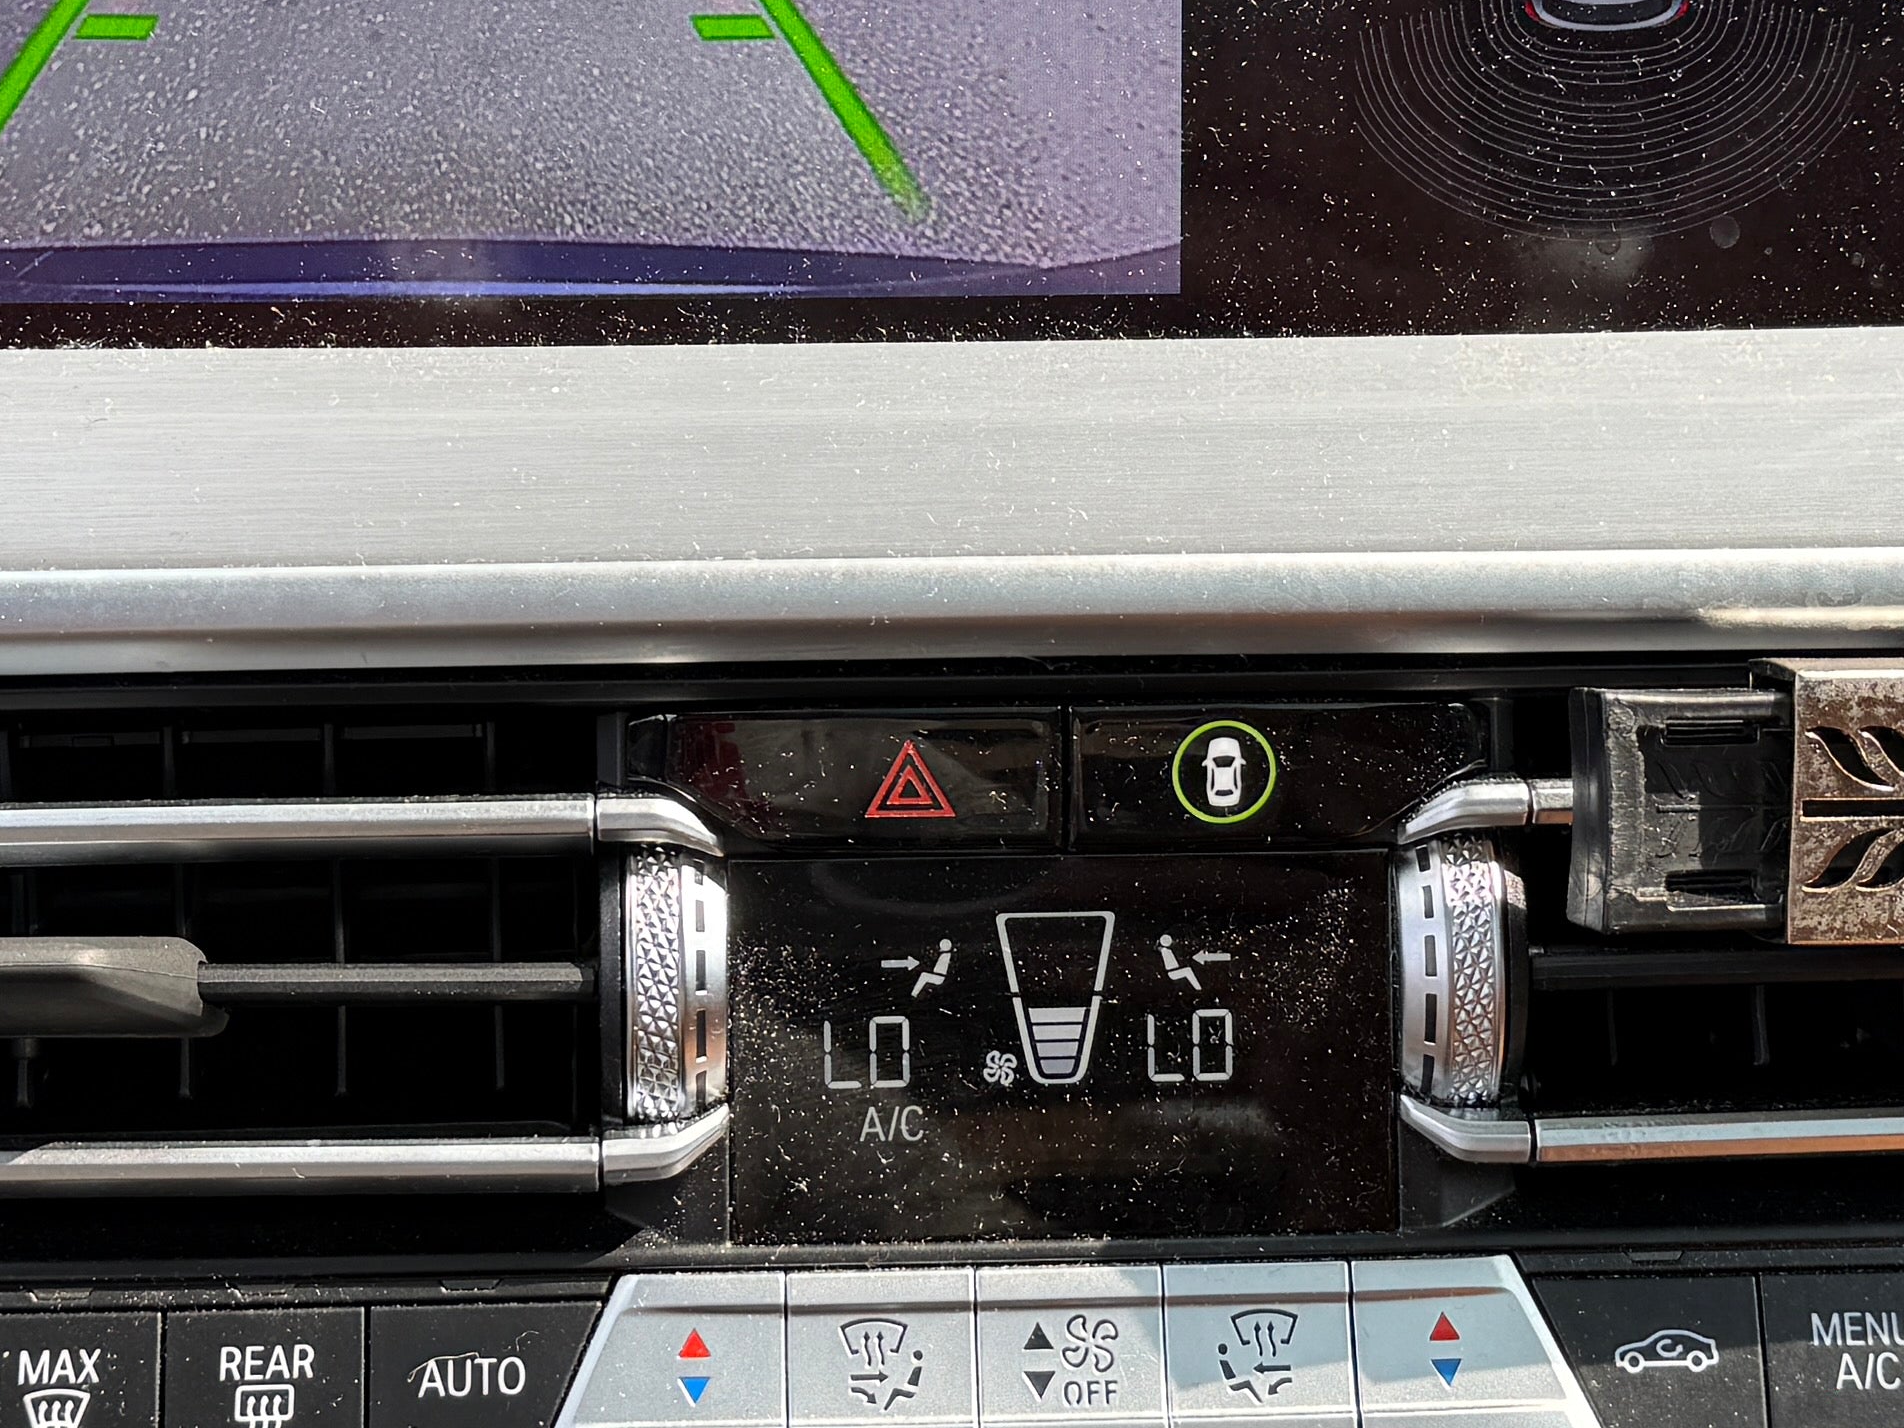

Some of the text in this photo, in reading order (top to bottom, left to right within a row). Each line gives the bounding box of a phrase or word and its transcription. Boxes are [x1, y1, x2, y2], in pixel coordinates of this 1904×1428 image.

[859, 1104, 926, 1143] A/C
[17, 1348, 102, 1386] MAX
[218, 1342, 315, 1383] REAR
[418, 1356, 527, 1399] AUTO
[1835, 1350, 1902, 1392] A/C
[1064, 1375, 1119, 1408] OFF
